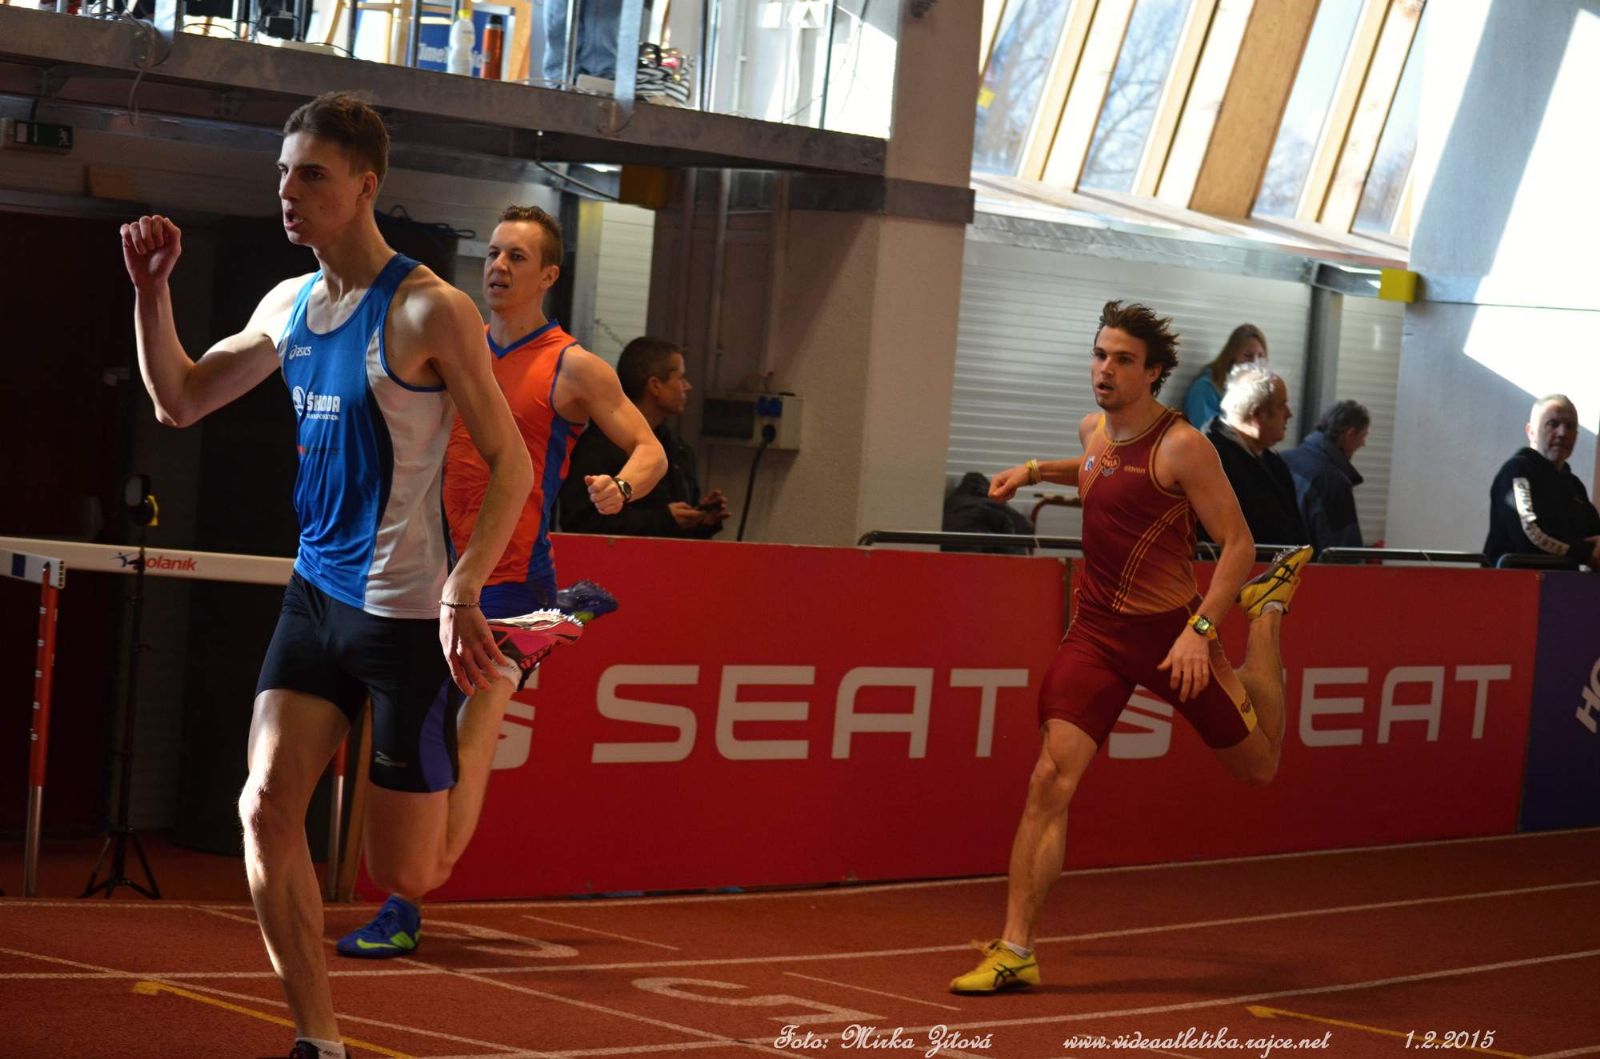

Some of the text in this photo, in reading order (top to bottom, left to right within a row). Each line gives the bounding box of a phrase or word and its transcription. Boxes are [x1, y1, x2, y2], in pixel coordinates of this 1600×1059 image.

[295, 345, 312, 357] asics
[144, 554, 197, 571] olanik
[591, 664, 1029, 764] SEAT
[1282, 665, 1512, 748] EAT
